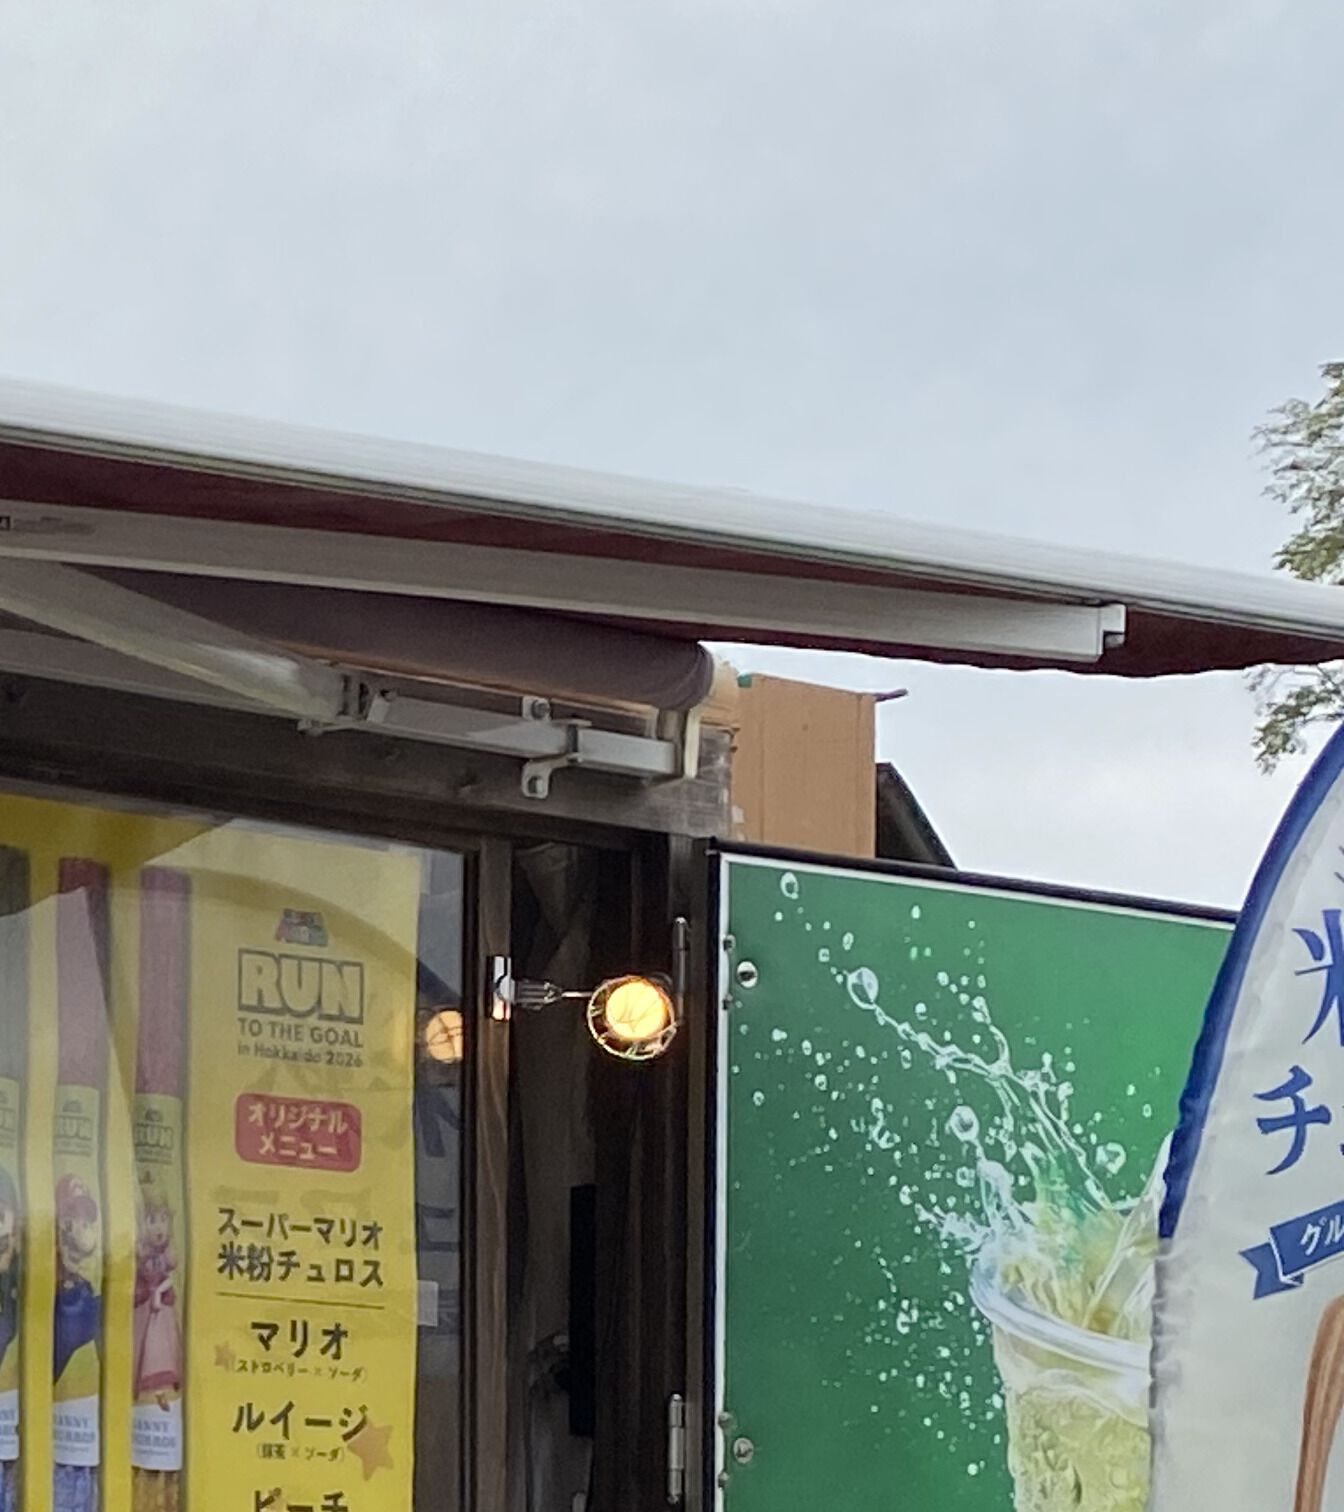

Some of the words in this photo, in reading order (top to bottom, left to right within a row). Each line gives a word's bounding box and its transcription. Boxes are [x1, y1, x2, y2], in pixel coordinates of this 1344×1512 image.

[238, 948, 364, 1025] RUN
[238, 1017, 262, 1037] TO
[269, 1021, 303, 1040] THE
[310, 1027, 363, 1048] GOAL
[248, 1103, 348, 1133] オリジナル
[260, 1133, 337, 1160] メニュー
[218, 1207, 383, 1250] スーパーマリオ
[218, 1241, 383, 1287] 米粉チュロス
[251, 1319, 348, 1360] マリオ
[232, 1400, 368, 1441] ルイージ
